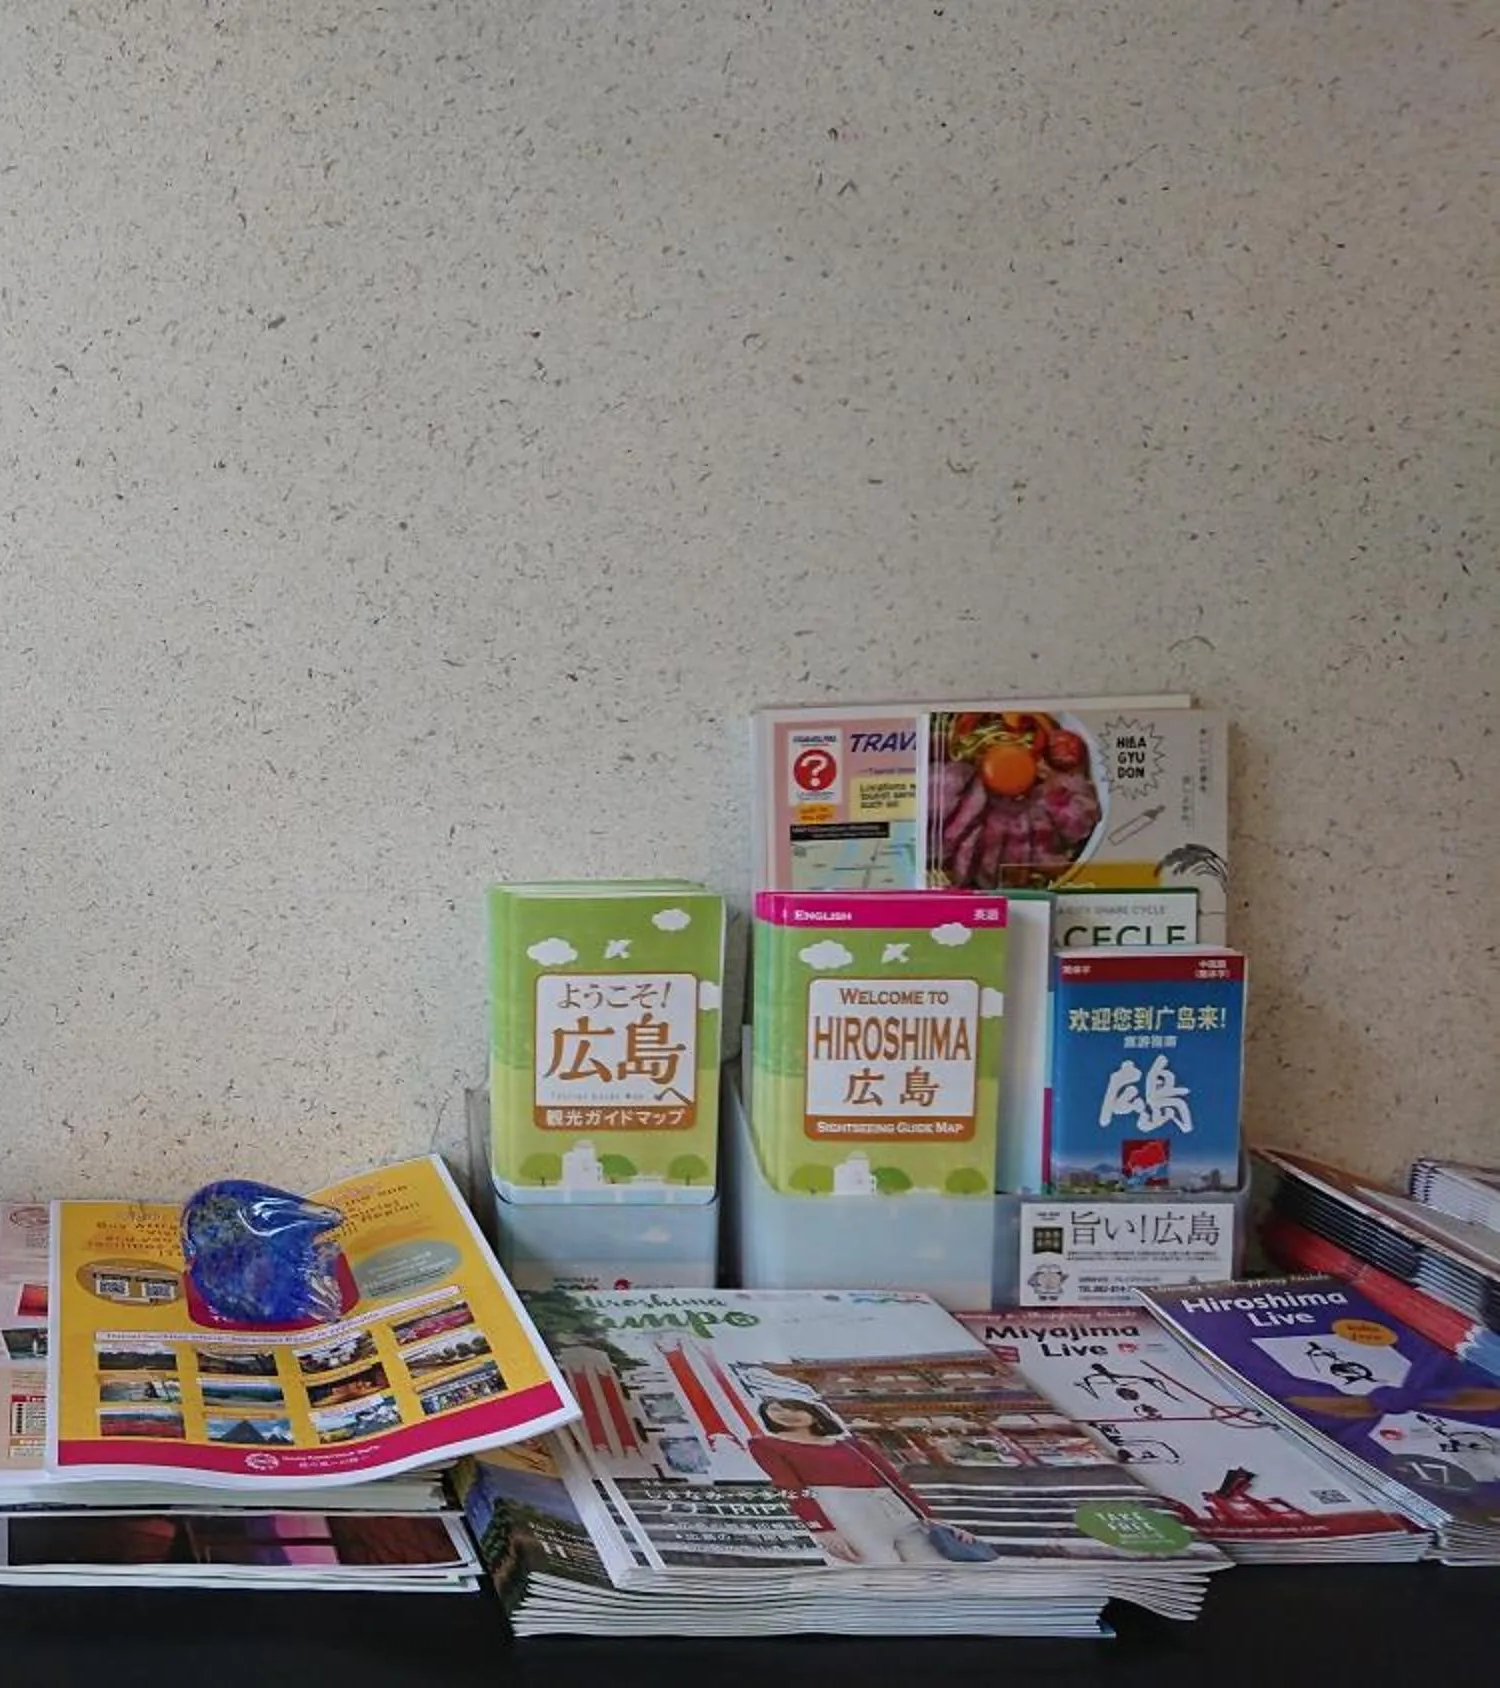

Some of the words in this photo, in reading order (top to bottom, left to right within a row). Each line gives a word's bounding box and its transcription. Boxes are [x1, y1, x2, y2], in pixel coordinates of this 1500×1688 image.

[850, 731, 916, 752] TRAV
[1117, 751, 1145, 763] GYU
[1117, 767, 1145, 778] DON
[794, 909, 852, 921] ENGLISH
[1054, 926, 1186, 946] CECLE
[558, 981, 672, 1009] ようこそ!
[839, 988, 923, 1005] WELCOME
[928, 991, 949, 1005] TO
[1068, 1005, 1227, 1032] 欢迎您到广岛来!
[813, 1016, 972, 1061] HIROSHIMA
[543, 1012, 687, 1085] 広島
[843, 1066, 940, 1107] 広島
[546, 1109, 685, 1126] 観光ガイドマップ
[816, 1121, 895, 1133] SIGHTSEEING
[896, 1121, 933, 1133] GUIDE
[935, 1121, 964, 1133] MAP
[1071, 1210, 1221, 1246] 旨い!広島
[1181, 1291, 1348, 1313] Hiroshima
[1247, 1310, 1317, 1327] Live
[985, 1324, 1141, 1342] Miyajima
[1041, 1343, 1109, 1357] Live
